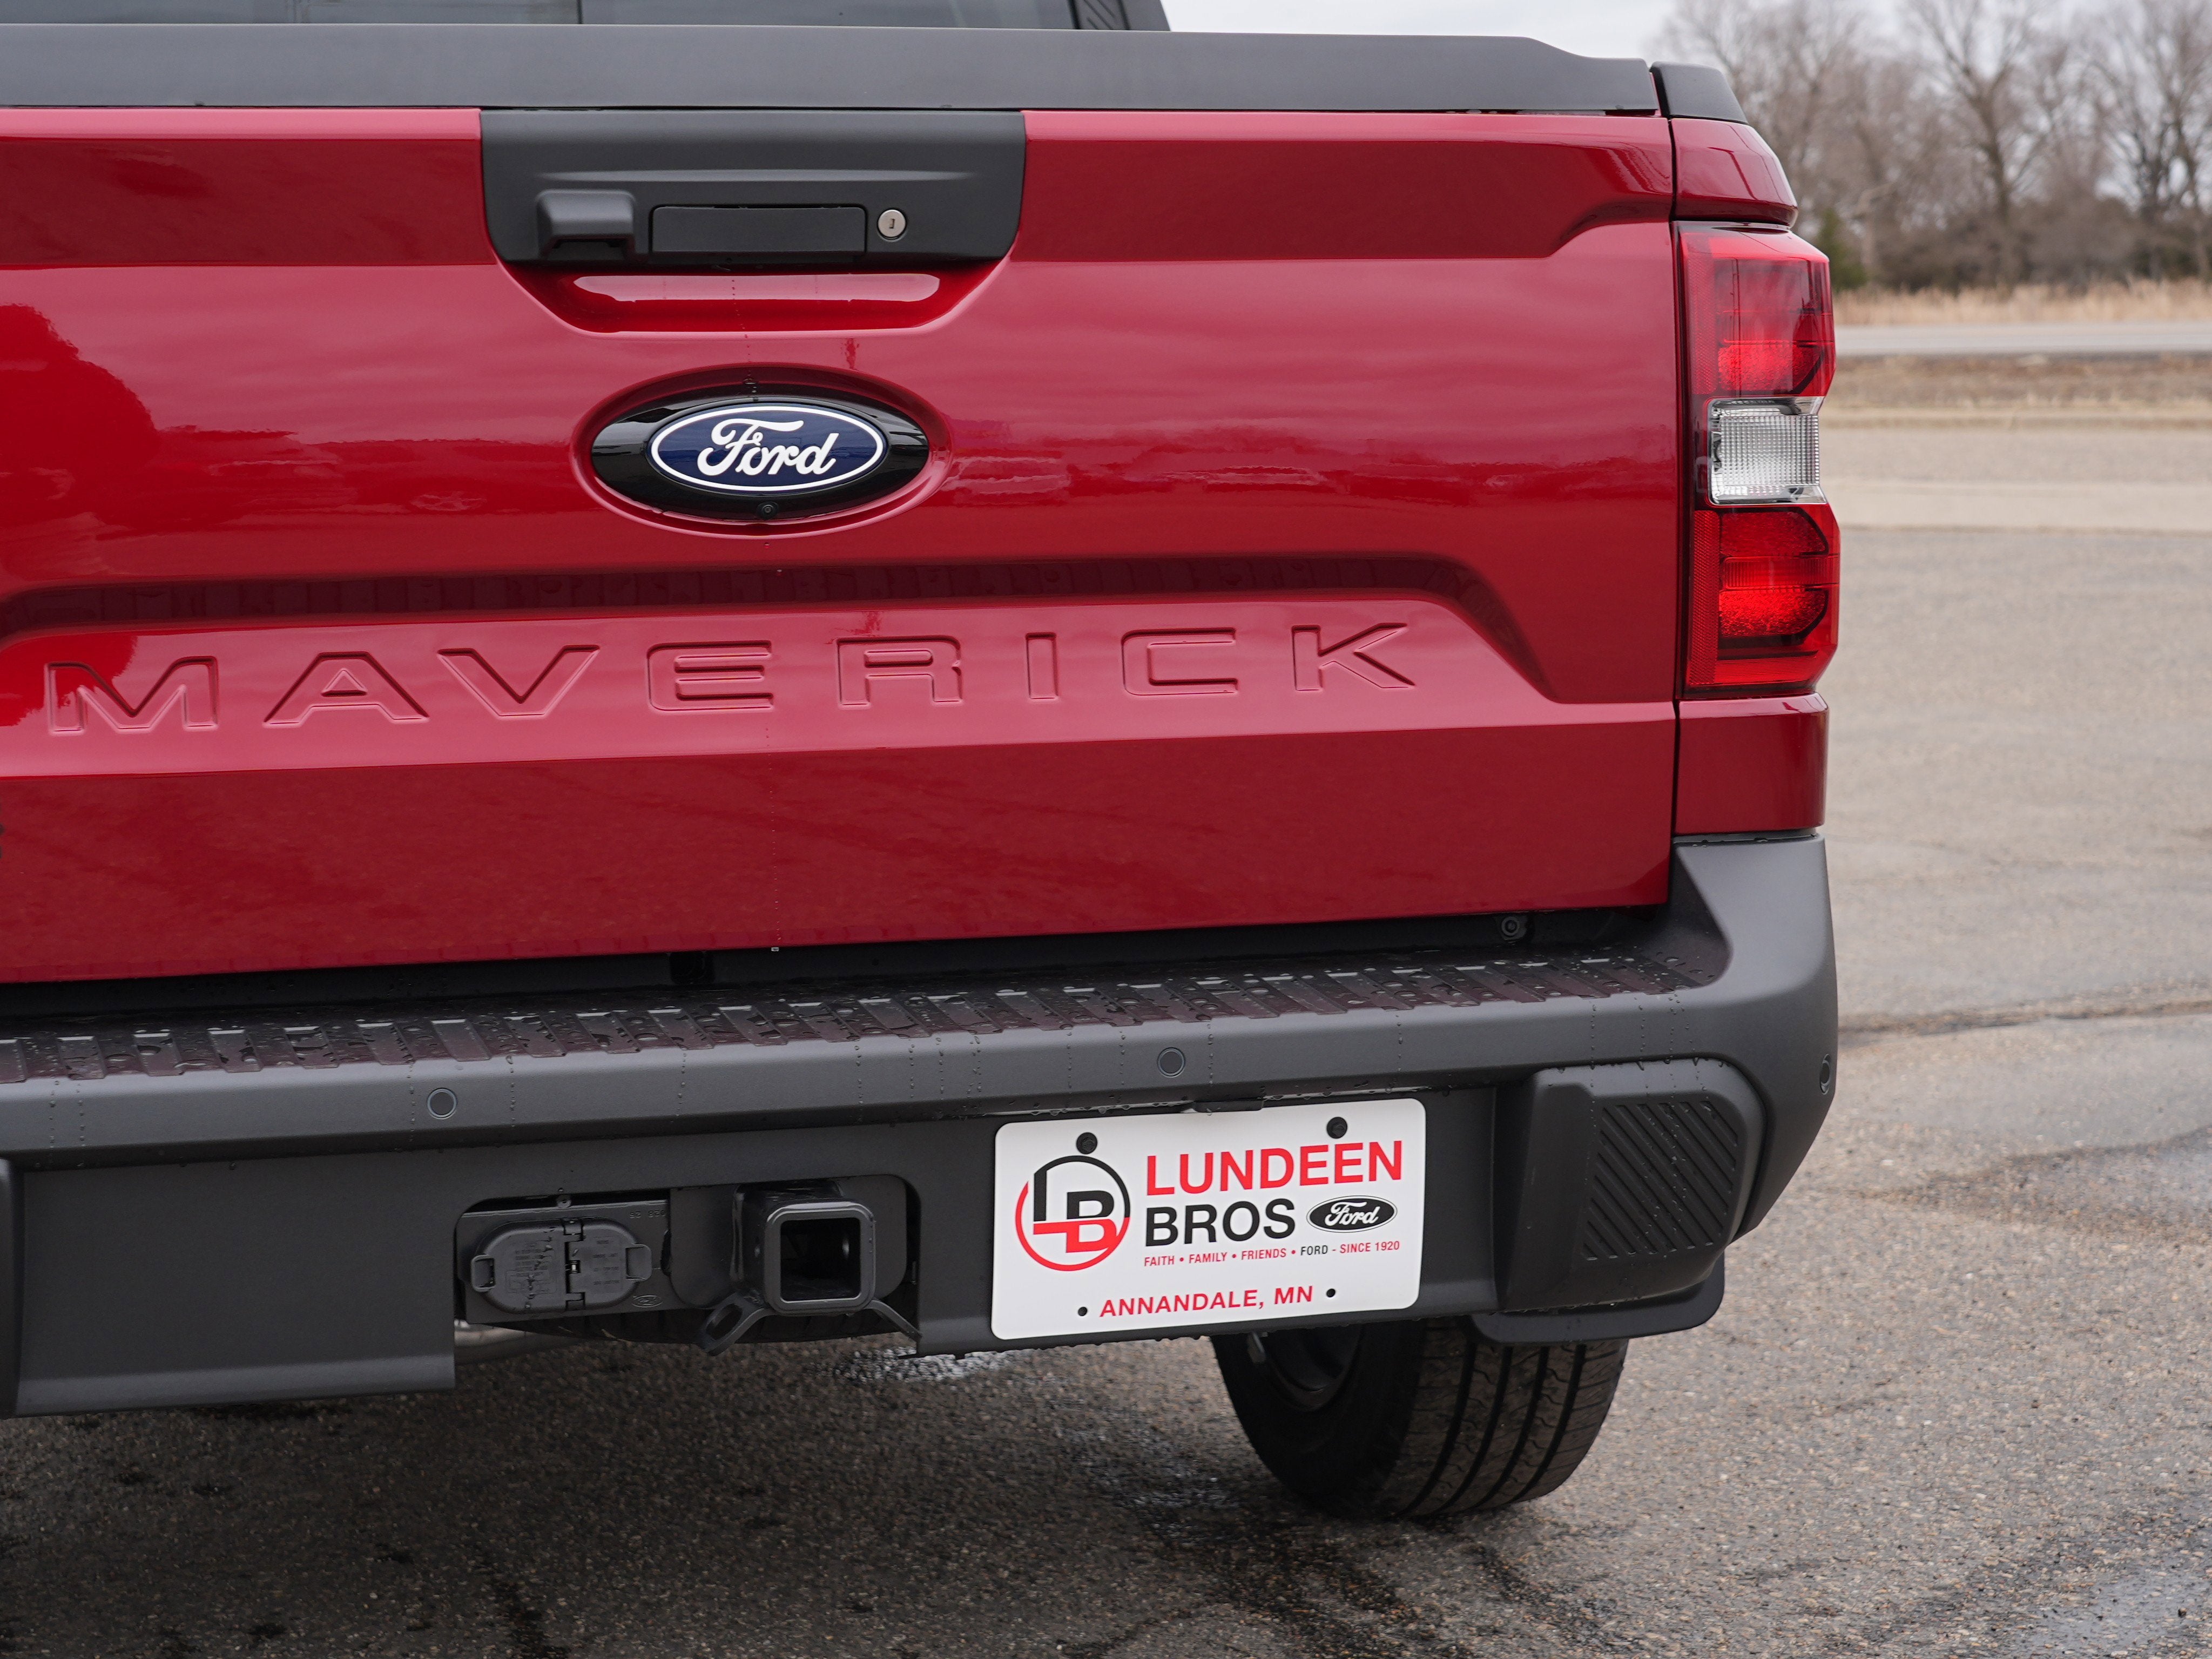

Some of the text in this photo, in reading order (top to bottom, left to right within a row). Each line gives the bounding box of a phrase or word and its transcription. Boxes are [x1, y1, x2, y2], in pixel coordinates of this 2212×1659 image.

[697, 418, 839, 476] Ford
[43, 622, 1415, 736] MAVERICK
[1147, 1140, 1402, 1196] LUNDEEN
[1145, 1198, 1295, 1246] BROS
[1324, 1201, 1379, 1226] Ford
[1144, 1256, 1175, 1266] FAITH
[1188, 1251, 1228, 1264] FAMILY
[1242, 1248, 1286, 1260] FRIENDS
[1300, 1245, 1328, 1256] FORD
[1340, 1242, 1371, 1253] SINCE
[1375, 1240, 1400, 1251] 1920
[1100, 1285, 1313, 1317] ANNANDALE, MN
